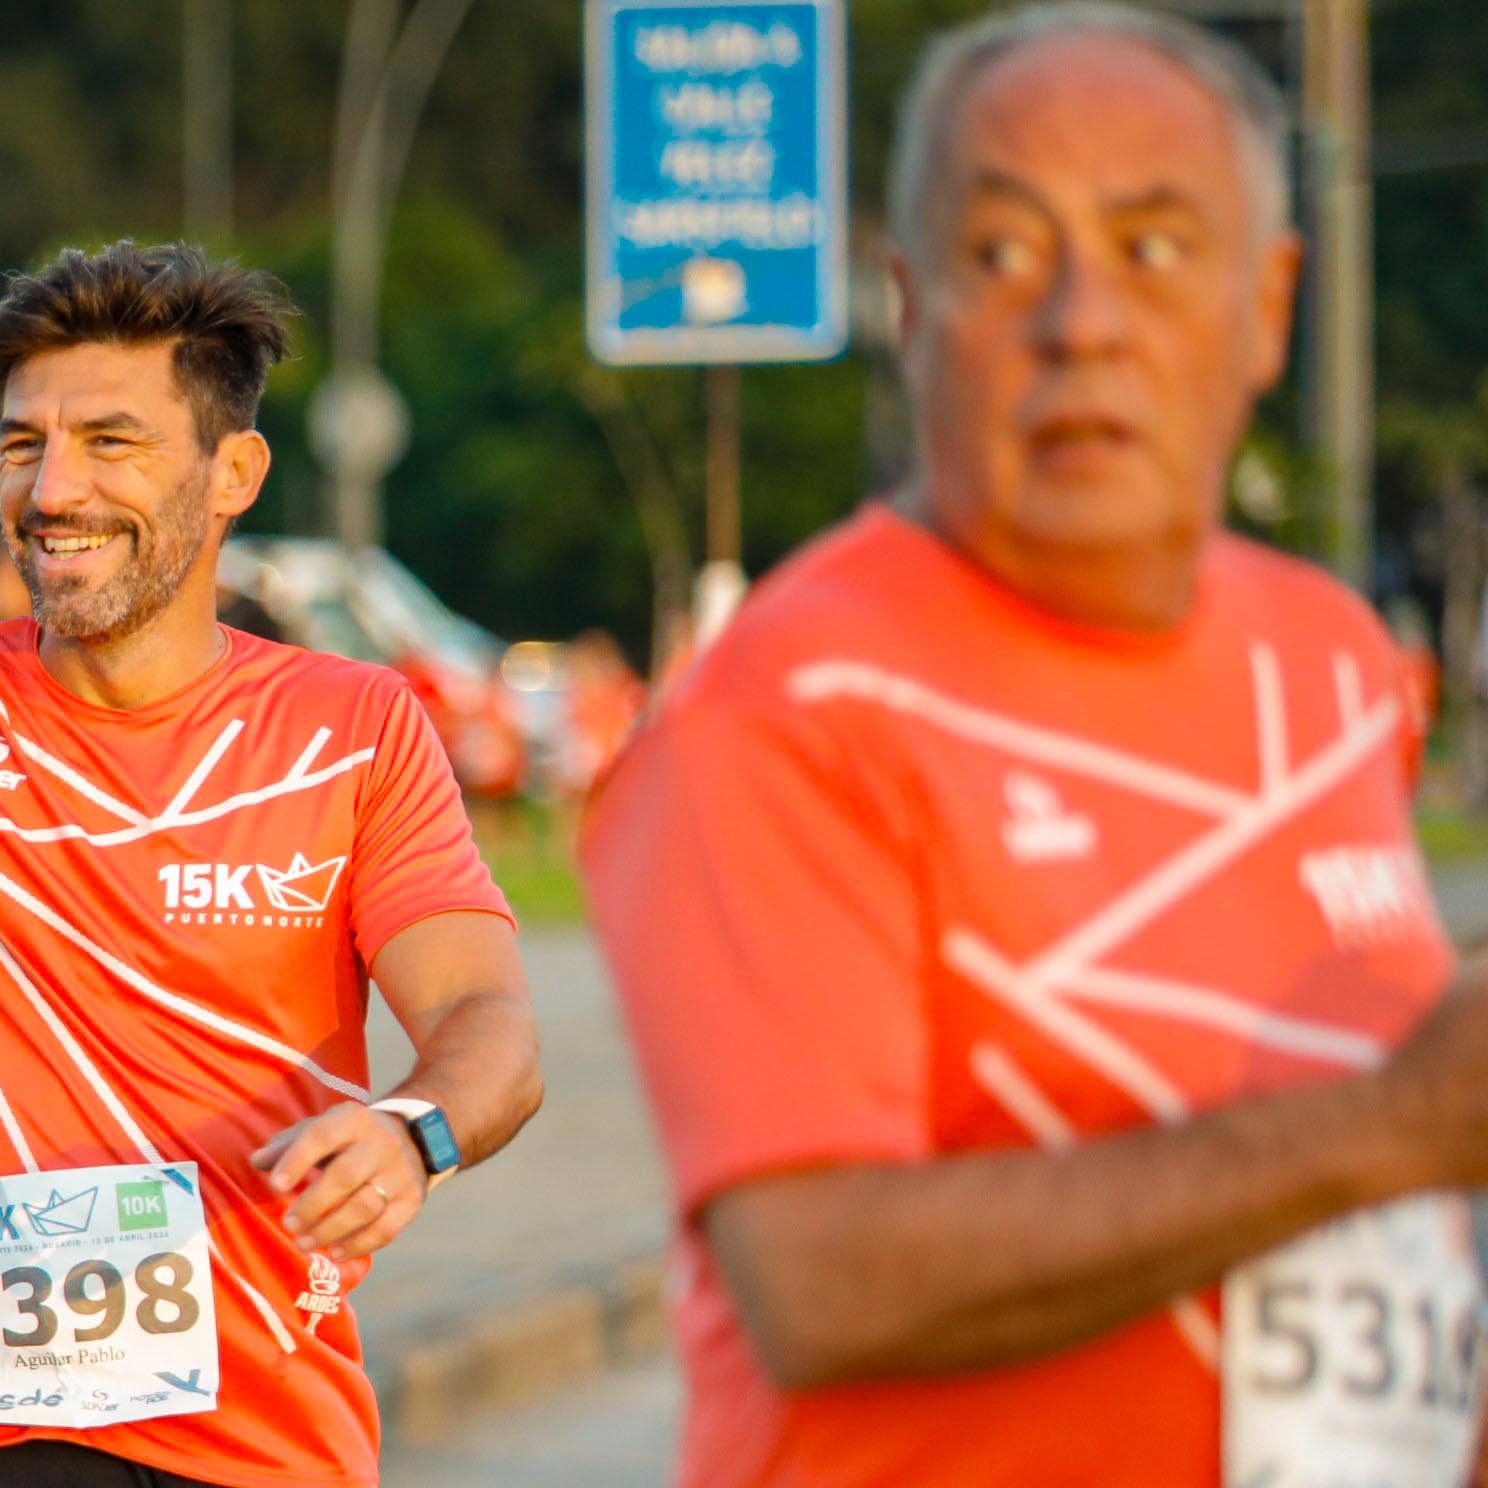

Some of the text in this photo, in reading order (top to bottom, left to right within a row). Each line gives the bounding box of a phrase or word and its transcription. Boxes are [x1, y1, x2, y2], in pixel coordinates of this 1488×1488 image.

[158, 863, 255, 909] 15K
[164, 912, 324, 929] PUERTO NORTE
[121, 1195, 162, 1217] 10K
[15, 1346, 126, 1370] Aguilar Pablo
